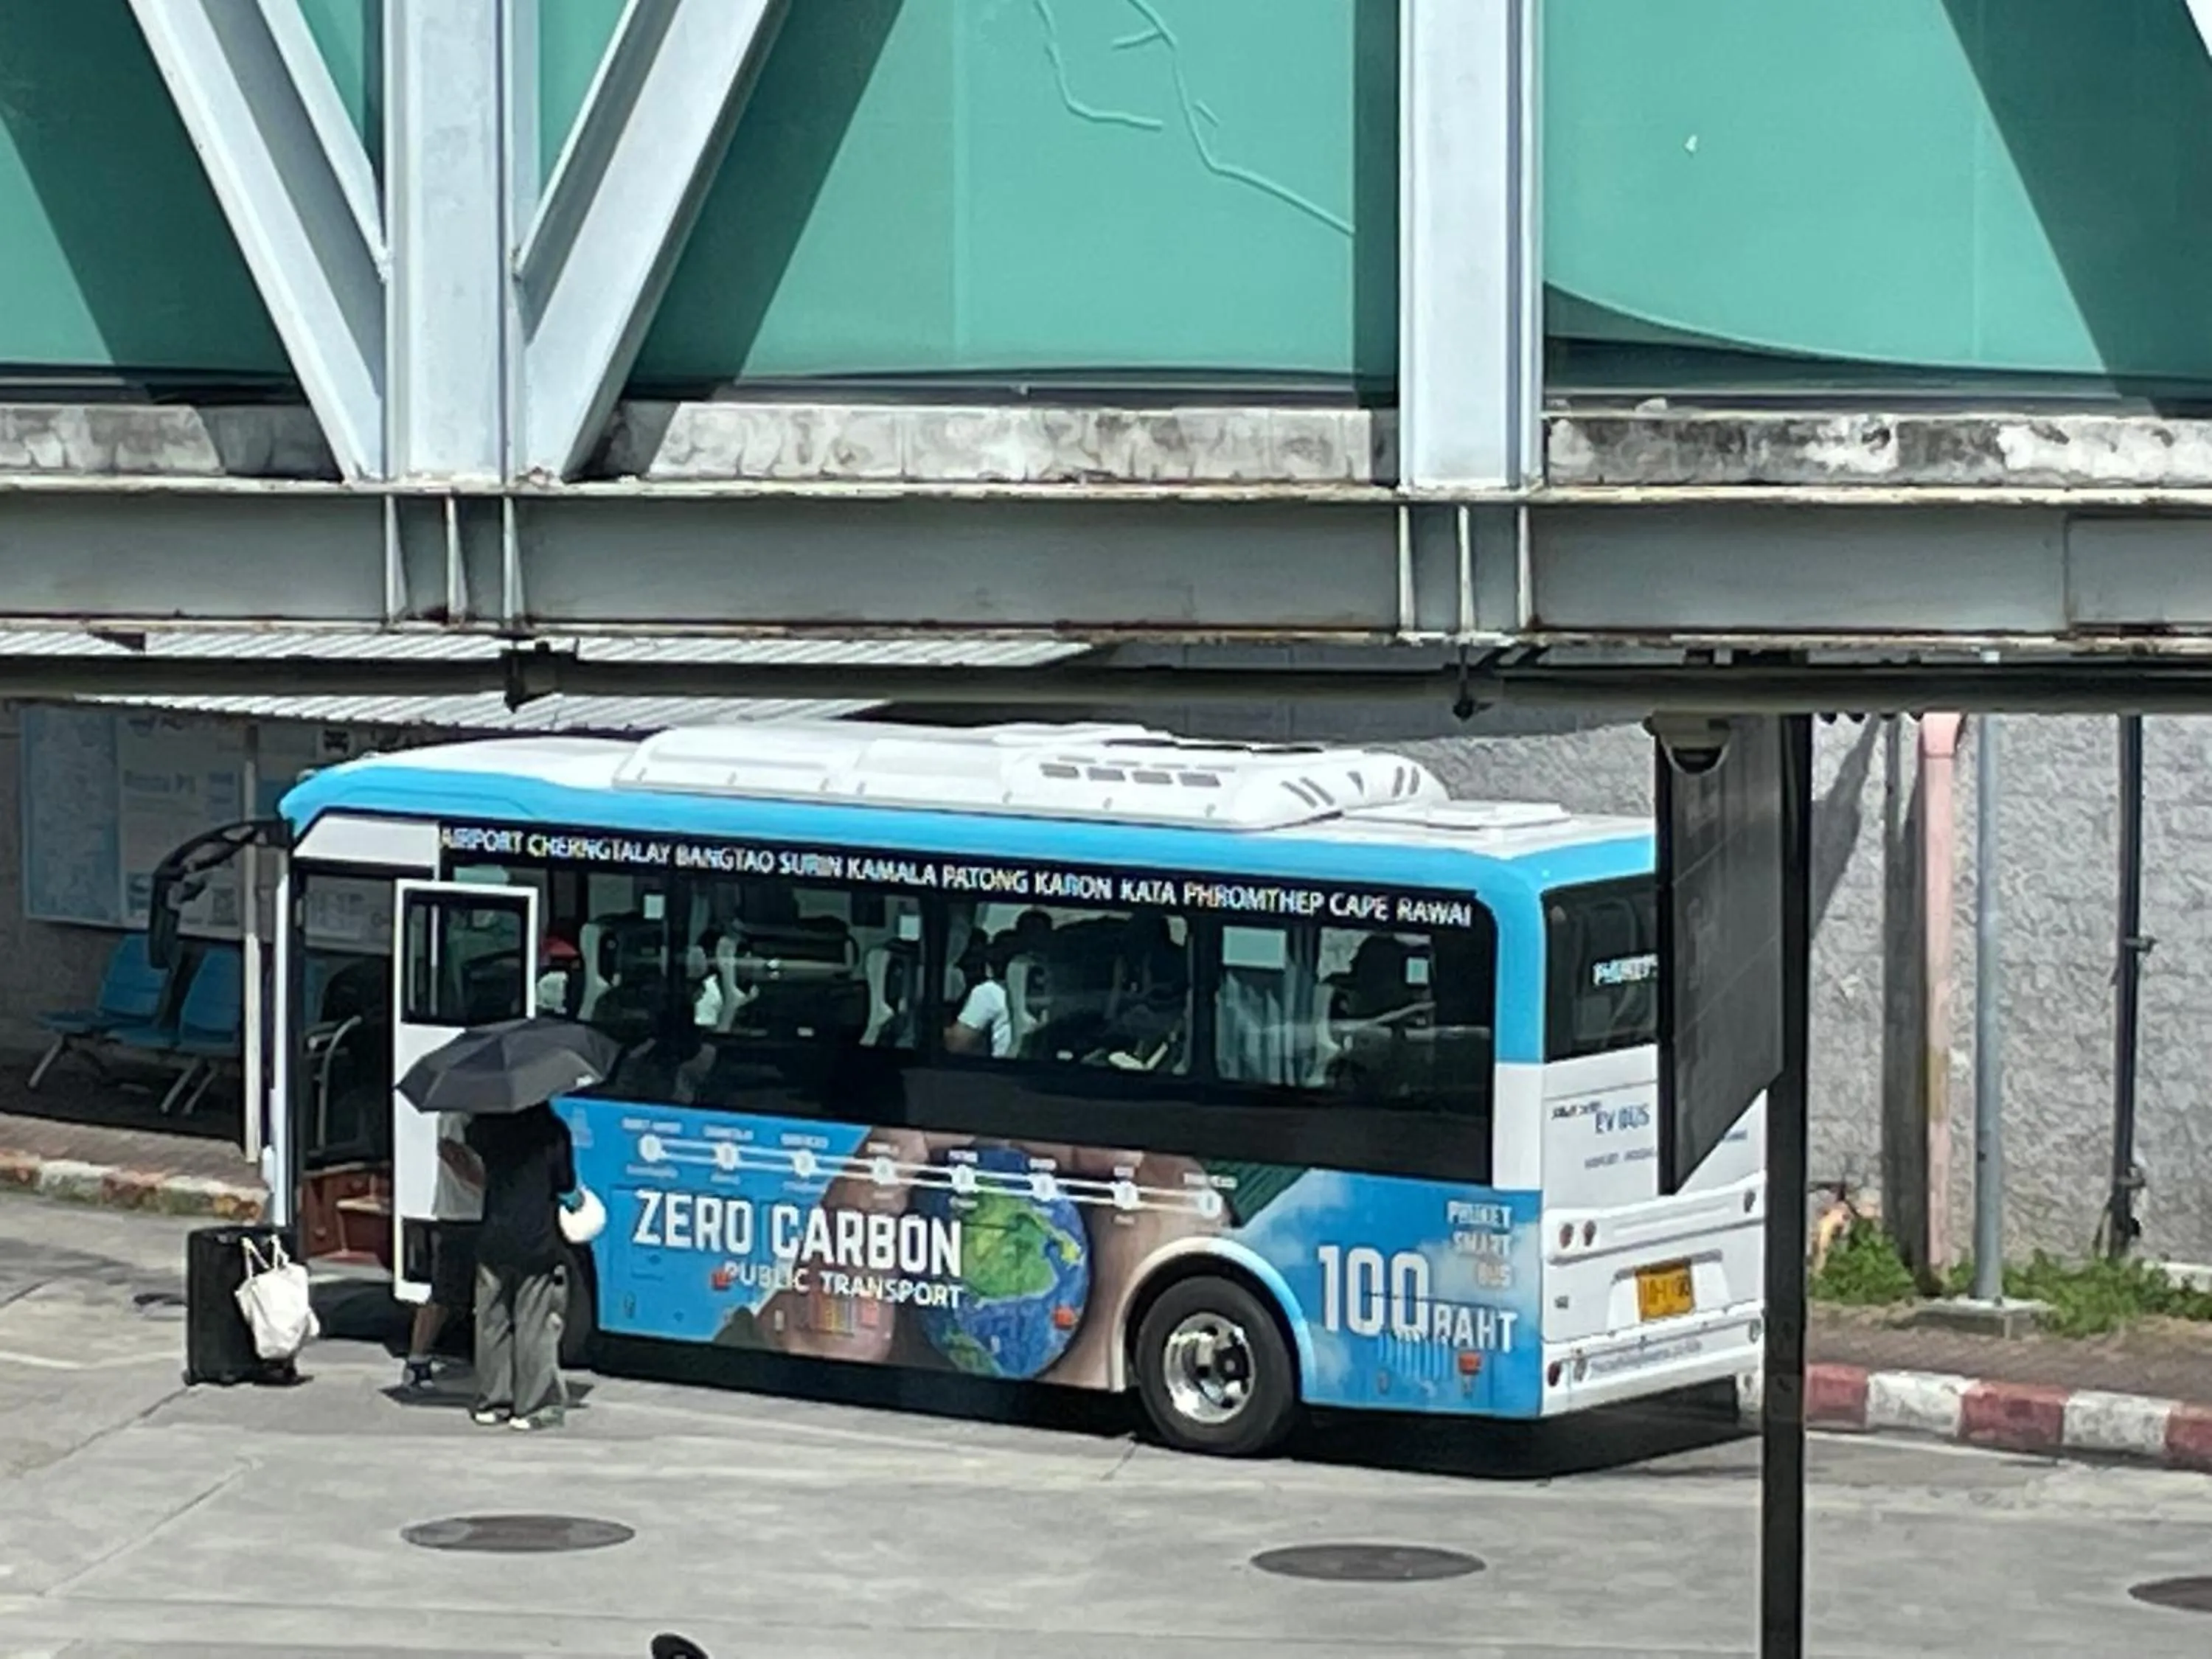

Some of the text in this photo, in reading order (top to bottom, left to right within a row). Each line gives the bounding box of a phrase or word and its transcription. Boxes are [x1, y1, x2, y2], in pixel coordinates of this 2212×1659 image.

[440, 827, 524, 854] AIRPORT
[675, 847, 773, 874] BANGTAO
[778, 852, 843, 878] SURIN
[847, 858, 935, 887] KAMALA
[942, 863, 1029, 894] PATONG
[1034, 872, 1113, 900] KARON
[1121, 877, 1177, 905] KATA
[1183, 883, 1325, 917] PHROMTHEP
[1329, 894, 1389, 921] CAPE
[1397, 899, 1473, 927] RAWAI
[632, 1189, 962, 1277] ZERO CARBON
[724, 1261, 964, 1310] PUBLIC TRANSPORT
[1318, 1245, 1430, 1342] 100
